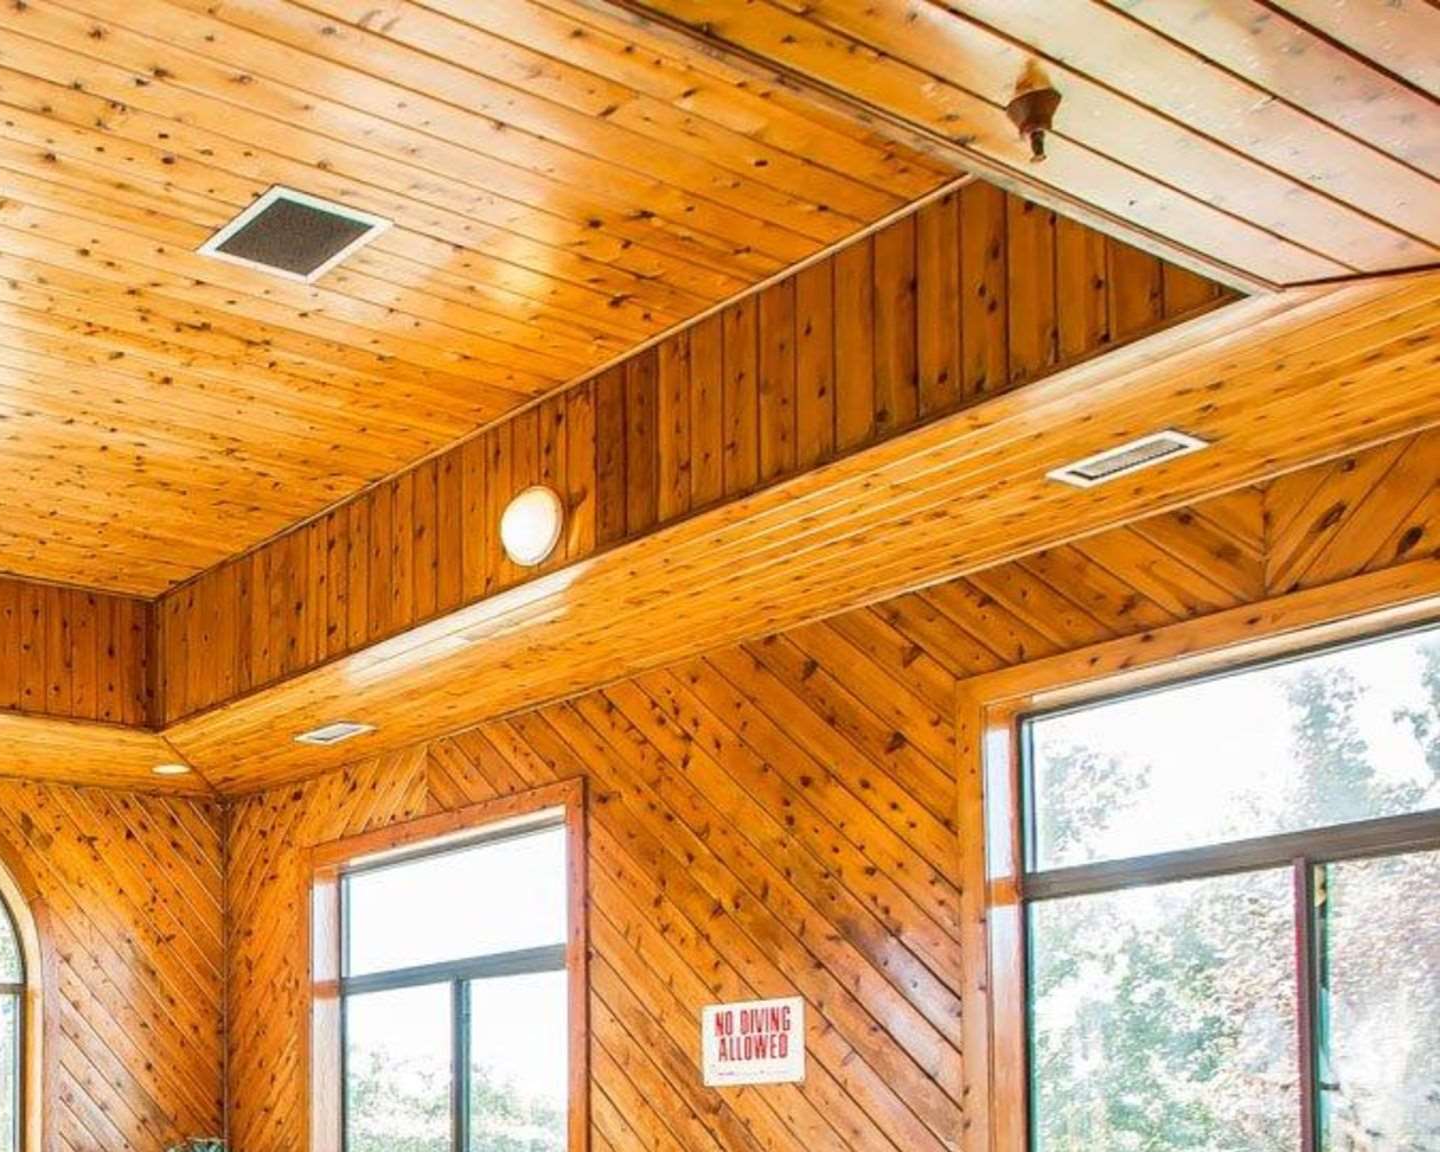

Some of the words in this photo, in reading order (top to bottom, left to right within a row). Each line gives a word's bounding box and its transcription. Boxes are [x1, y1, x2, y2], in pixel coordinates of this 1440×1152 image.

[715, 1011, 733, 1036] NO
[740, 1006, 791, 1035] DIVING
[718, 1033, 788, 1062] ALLOWED
